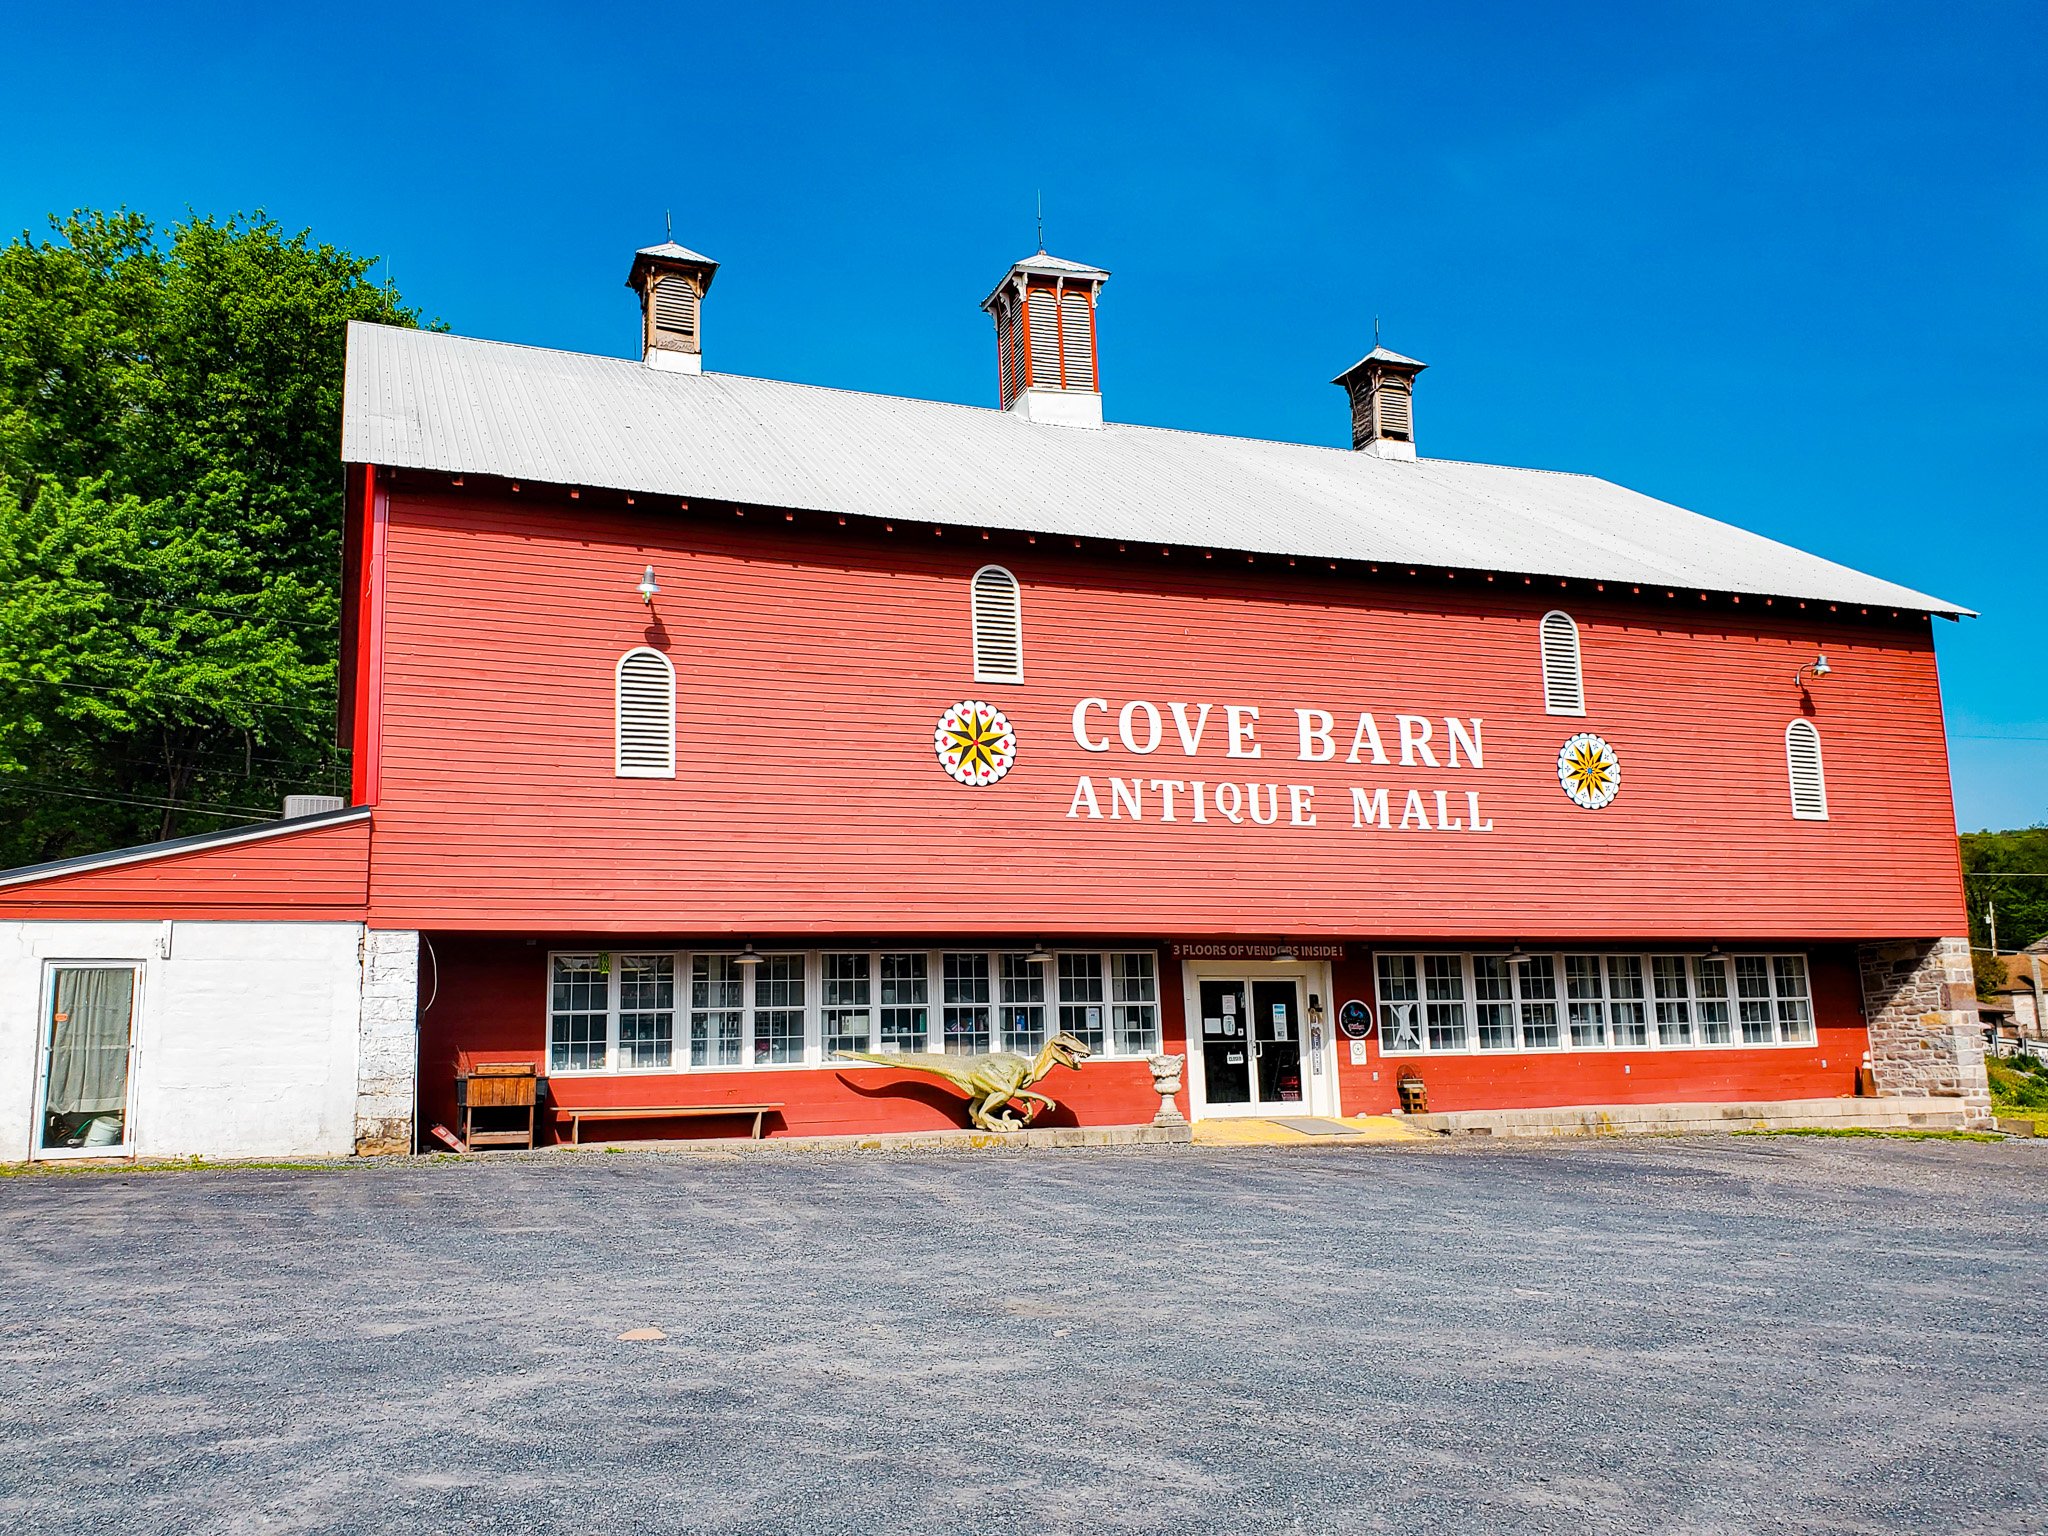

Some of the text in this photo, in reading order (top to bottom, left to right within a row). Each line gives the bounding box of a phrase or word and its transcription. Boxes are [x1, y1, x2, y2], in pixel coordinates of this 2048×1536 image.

[1071, 697, 1485, 769] COVE BARN
[1066, 775, 1494, 832] ANTIQUE MALL
[1173, 944, 1180, 956] 3
[1183, 944, 1227, 956] FLOORS
[1229, 945, 1244, 956] OF
